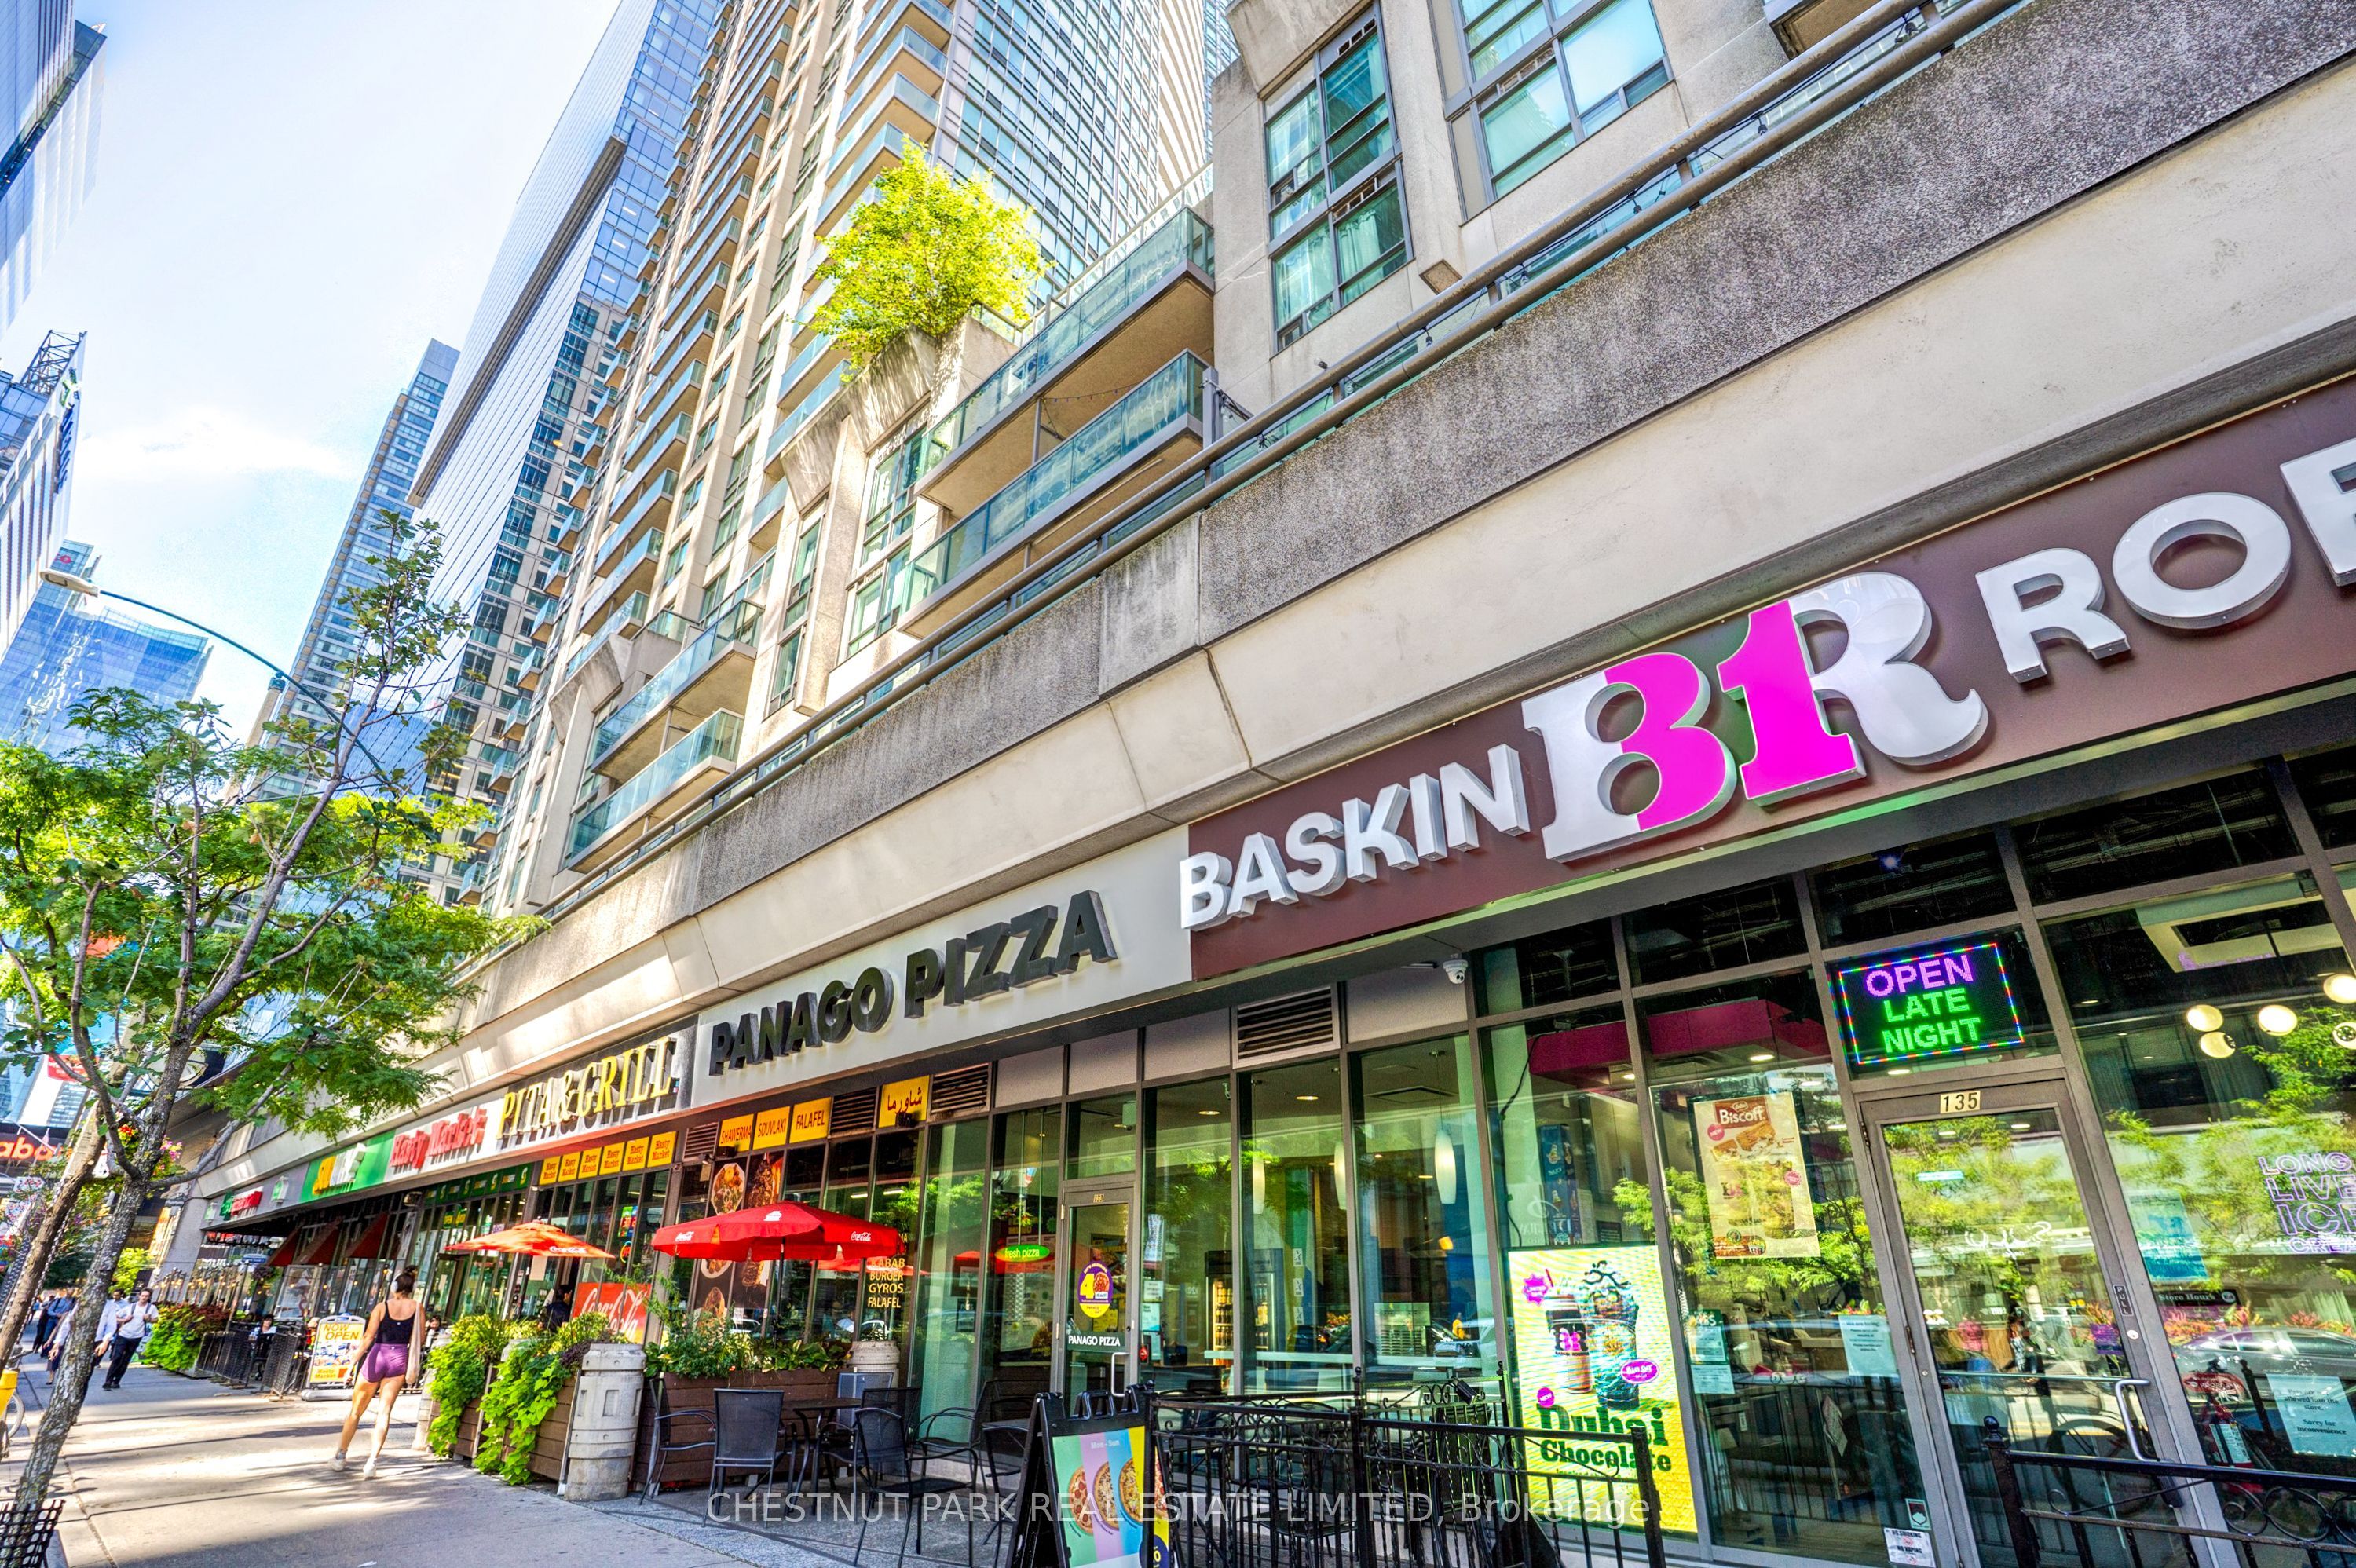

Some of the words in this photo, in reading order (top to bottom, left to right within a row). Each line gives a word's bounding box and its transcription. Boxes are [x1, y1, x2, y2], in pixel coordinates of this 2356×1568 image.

[1180, 743, 1530, 930] BASKIN
[1865, 954, 1974, 997] OPEN
[708, 967, 894, 1076] PANAGO
[904, 889, 1118, 1018] PIZZA
[1883, 987, 1970, 1022] LATE
[1882, 1017, 1981, 1053] NIGHT
[576, 1036, 674, 1117] GRILL
[887, 1087, 923, 1115] شاورما
[1942, 1091, 1978, 1112] 135
[796, 1110, 825, 1130] FALAFEL
[1719, 1105, 1765, 1124] Biscoff
[757, 1117, 786, 1138] SOUVLAKI
[1710, 1128, 1723, 1137] NEW
[390, 1129, 430, 1169] Hasty
[425, 1108, 488, 1157] Market
[720, 1124, 752, 1145] SHAWERMA
[631, 1145, 645, 1154] Hasty
[655, 1139, 671, 1150] Hasty
[585, 1154, 597, 1163] Hasty
[607, 1150, 620, 1159] Hasty
[627, 1155, 644, 1164] Market
[652, 1150, 670, 1160] Market
[582, 1164, 597, 1174] Market
[604, 1160, 619, 1169] Market
[2258, 1152, 2352, 1175] LONG
[562, 1168, 576, 1177] Market
[2265, 1175, 2356, 1201] LIVE
[1004, 1248, 1021, 1258] fresh
[1022, 1248, 1040, 1259] pizza
[871, 1258, 905, 1268] KABAB
[869, 1270, 904, 1281] BURGER
[869, 1282, 904, 1293] GYROS
[867, 1296, 902, 1308] FALAFEL
[2116, 1286, 2129, 1314] PULL
[325, 1332, 359, 1340] OPEN
[1068, 1335, 1098, 1347] PANAGO
[1099, 1336, 1121, 1347] PIZZA
[1536, 1403, 1669, 1446] Dubi
[2296, 1426, 2347, 1435] inconvenience
